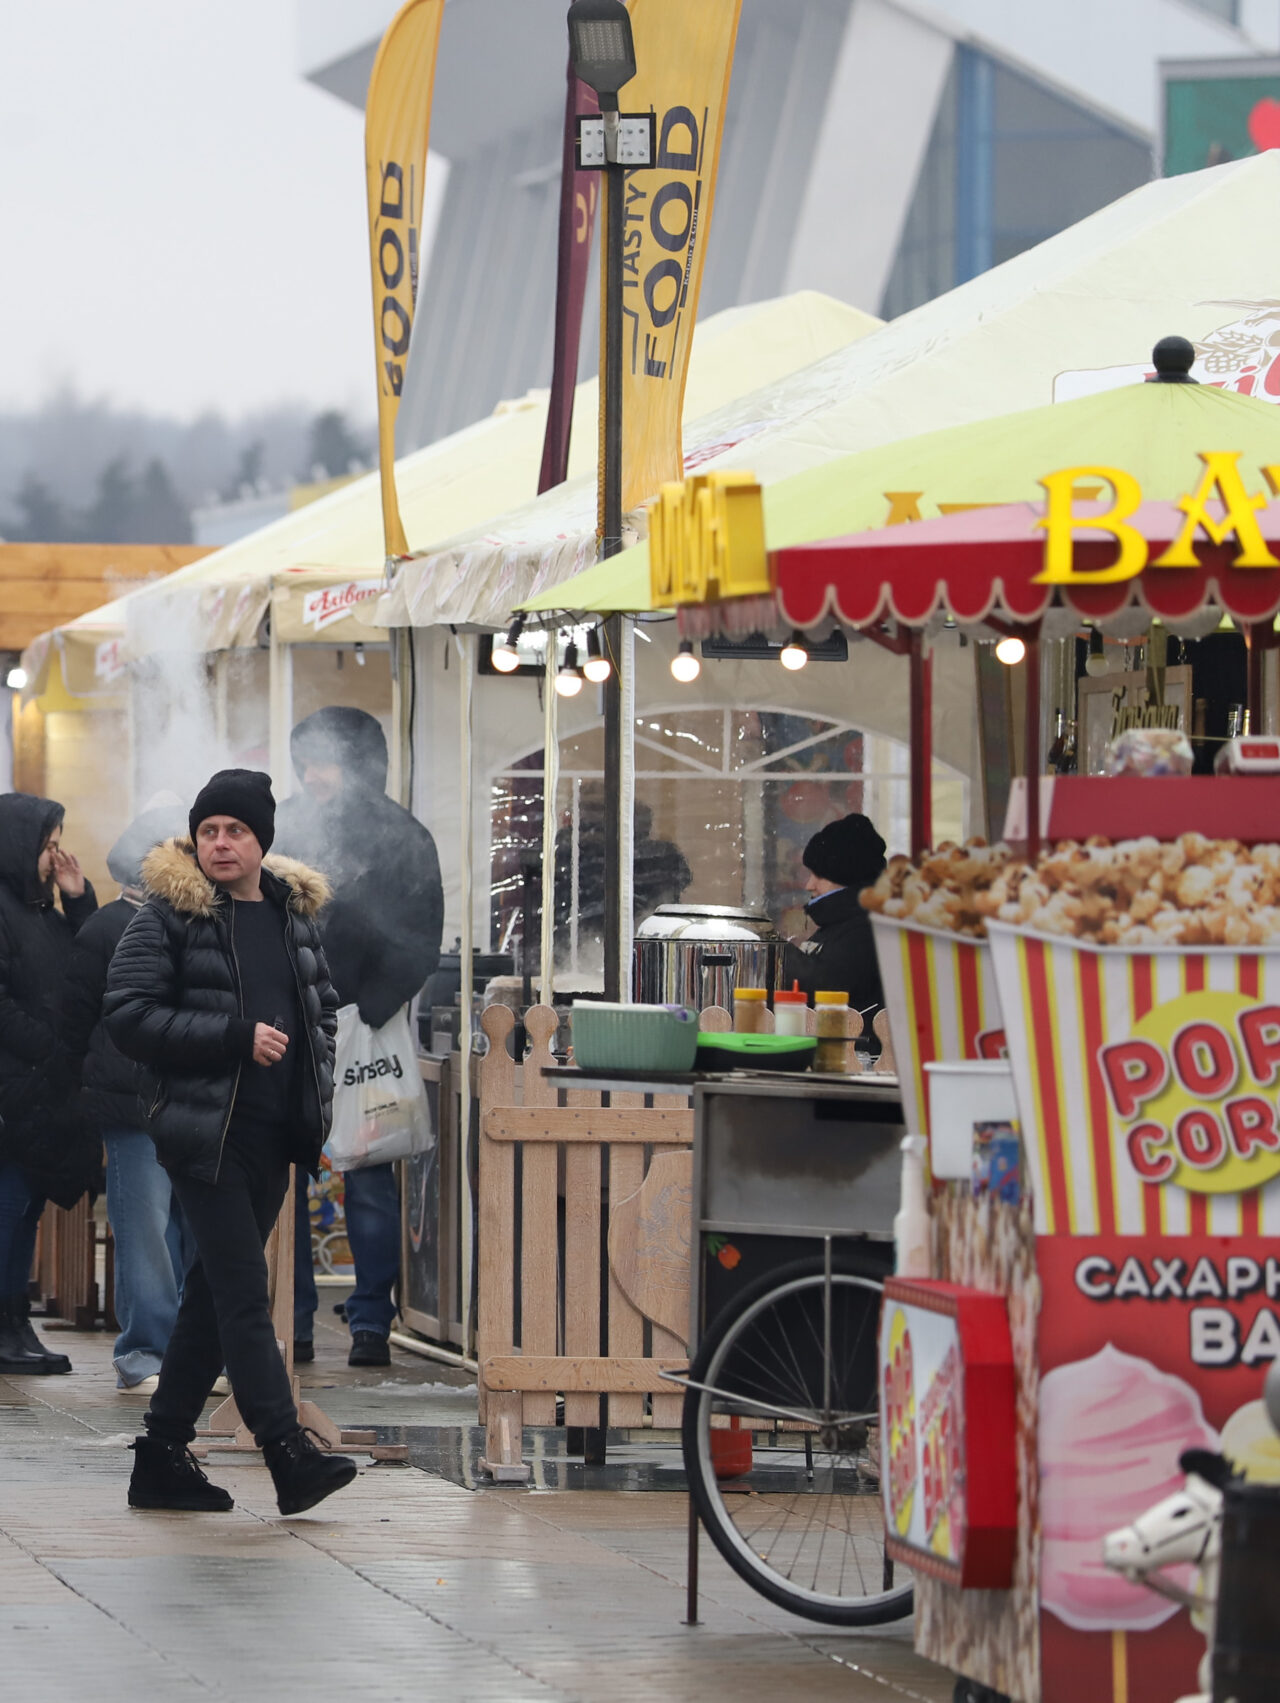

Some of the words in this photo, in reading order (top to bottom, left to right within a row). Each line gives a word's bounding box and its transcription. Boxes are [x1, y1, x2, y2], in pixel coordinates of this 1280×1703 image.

[643, 106, 699, 378] FOOD
[1029, 451, 1280, 584] ВА
[343, 1054, 404, 1086] sinsay
[1097, 1005, 1280, 1121] POP
